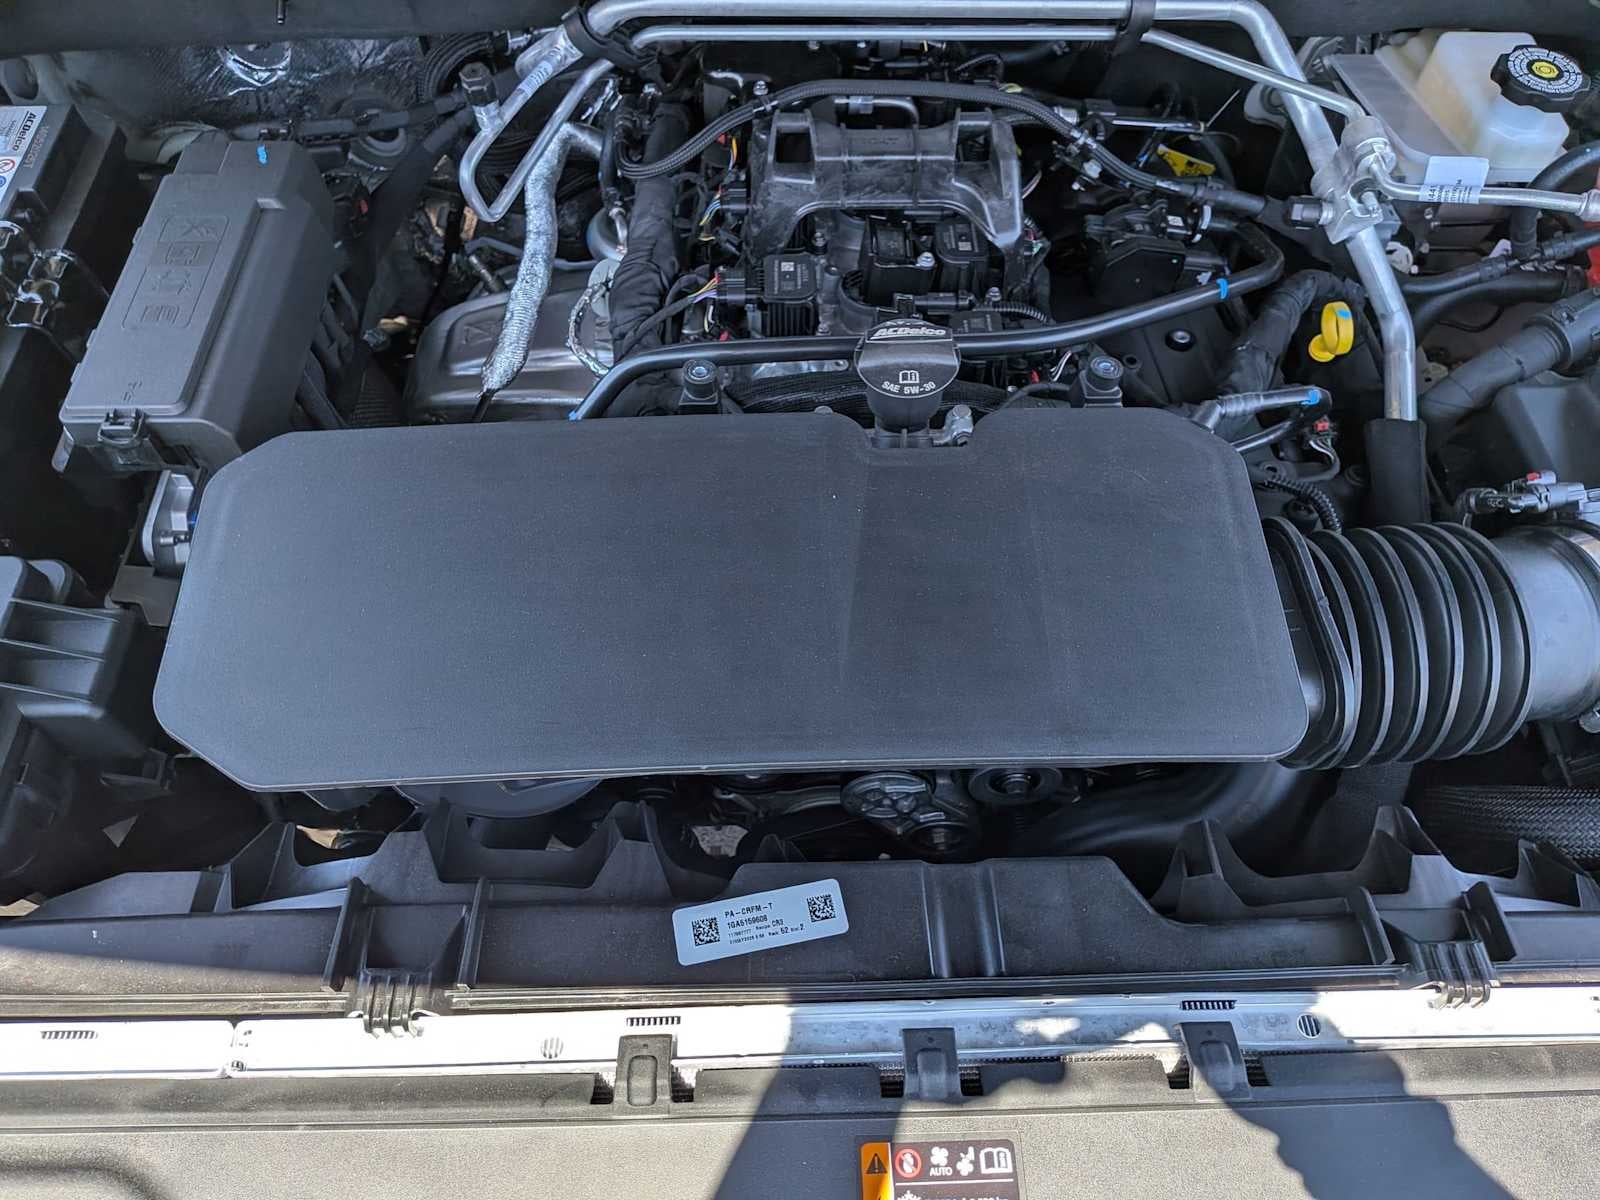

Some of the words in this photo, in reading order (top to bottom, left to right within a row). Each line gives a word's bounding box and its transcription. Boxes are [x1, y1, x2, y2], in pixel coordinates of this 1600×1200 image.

[12, 112, 37, 152] ACDelco
[872, 327, 947, 337] ACDelco
[881, 381, 900, 393] SAE
[903, 381, 936, 394] 5W-30
[929, 1167, 952, 1177] AUTO
